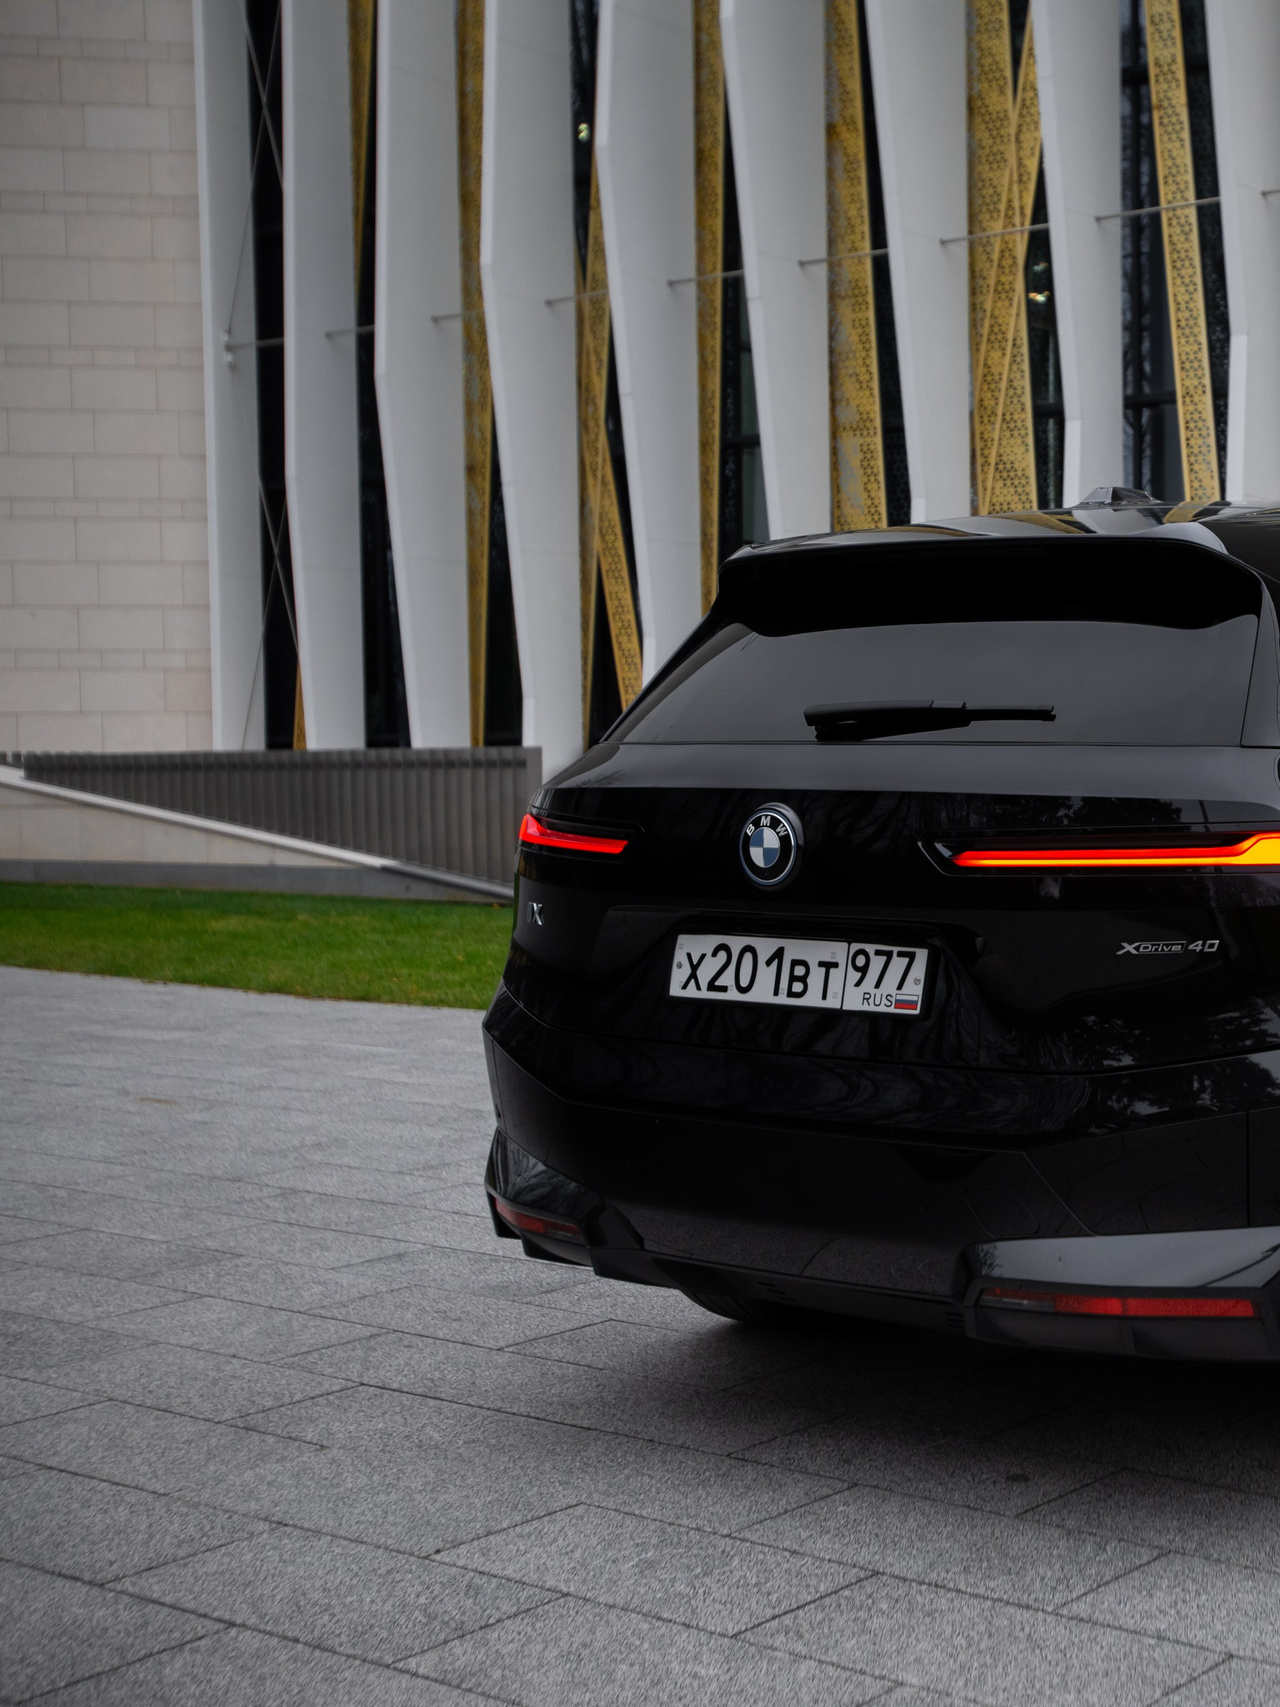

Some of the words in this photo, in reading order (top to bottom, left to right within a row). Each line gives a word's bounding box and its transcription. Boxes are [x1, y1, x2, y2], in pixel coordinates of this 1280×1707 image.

[745, 815, 788, 837] BMW
[1187, 940, 1220, 952] 40
[851, 948, 917, 991] 977
[861, 992, 893, 1008] RUS
